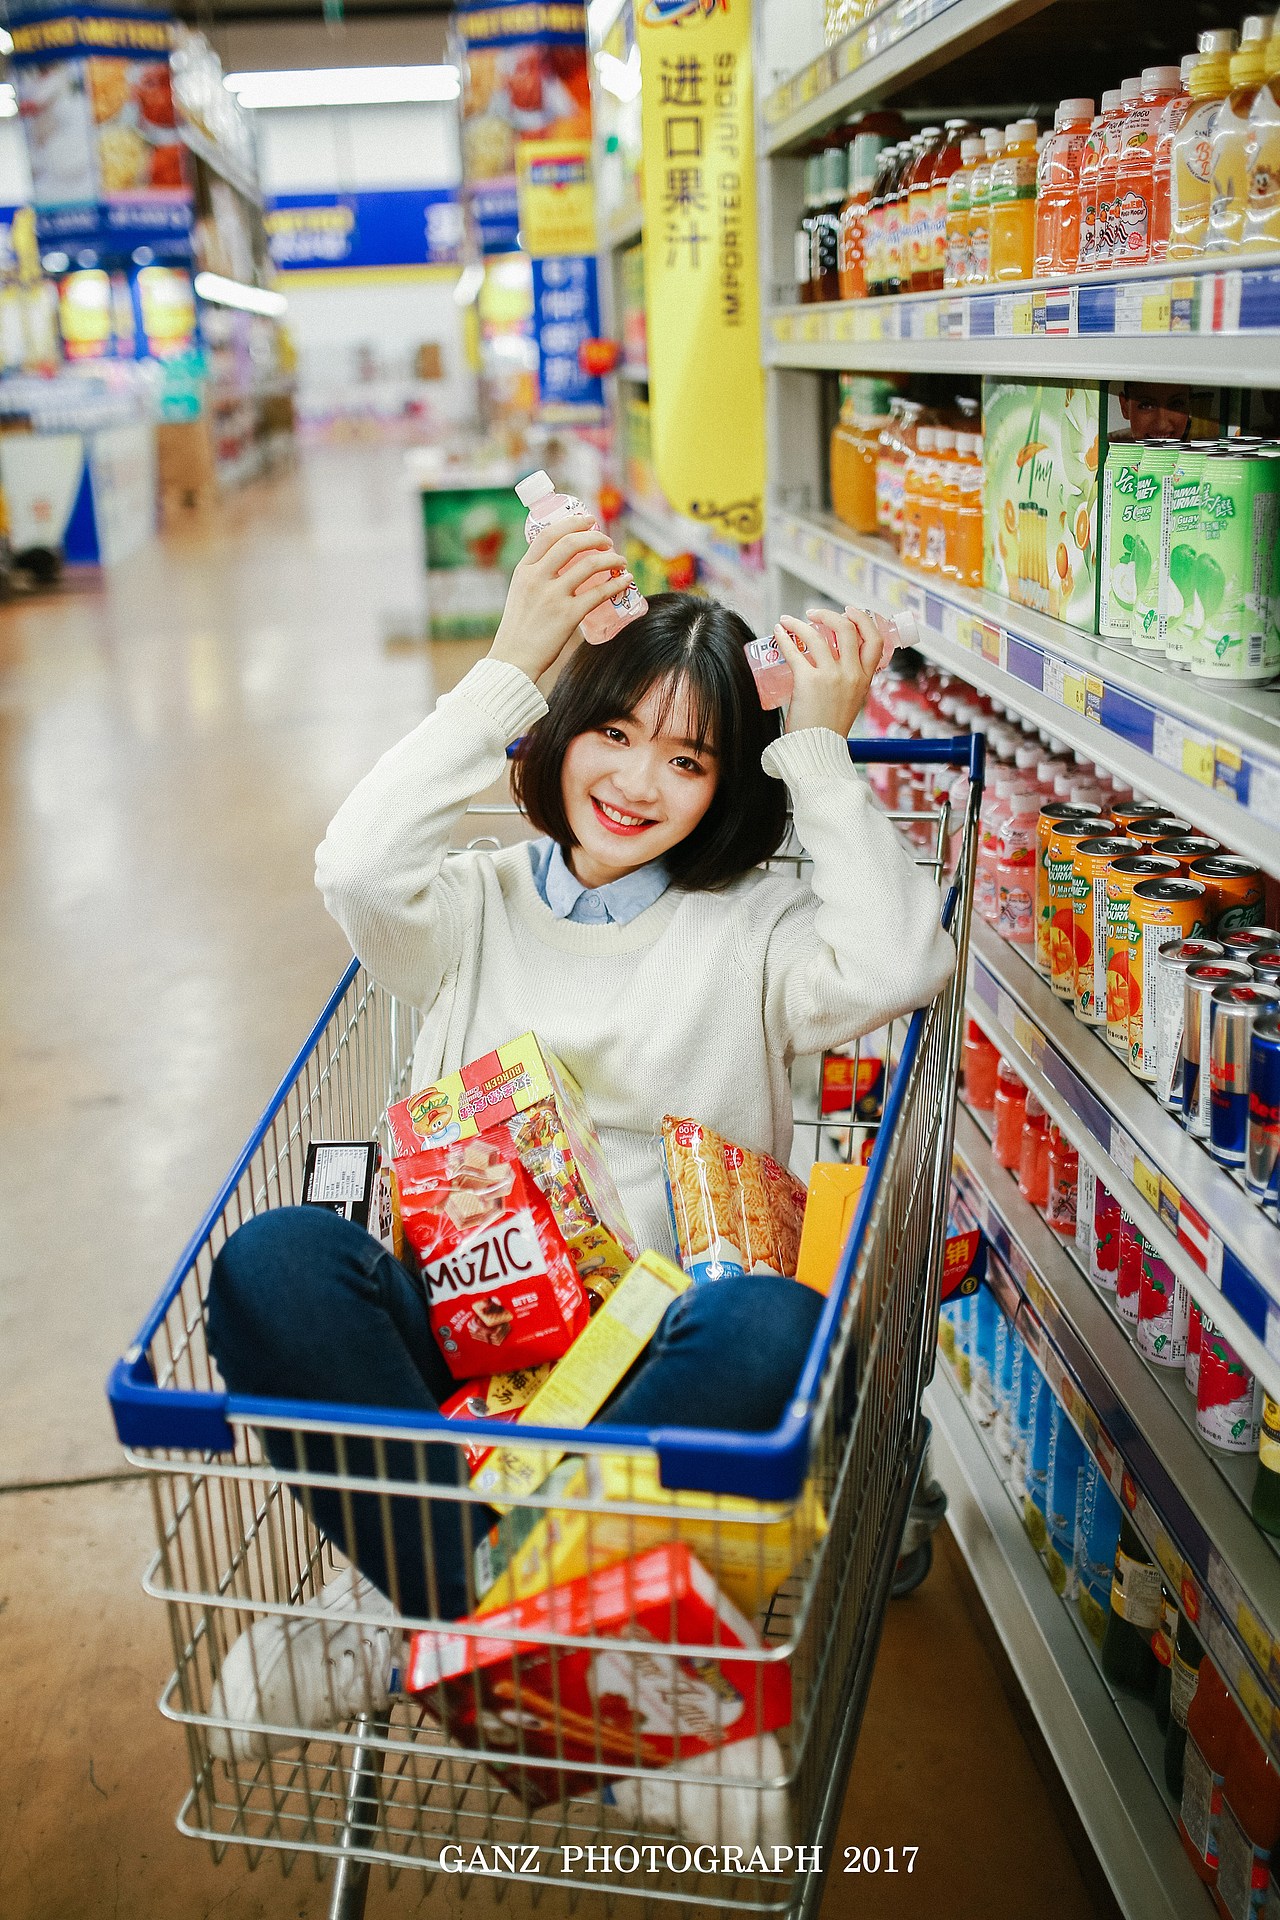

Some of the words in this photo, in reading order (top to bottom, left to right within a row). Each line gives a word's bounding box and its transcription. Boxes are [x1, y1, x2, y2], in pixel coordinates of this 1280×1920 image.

[713, 52, 740, 160] JUICES
[660, 53, 708, 270] 进口果汁
[717, 171, 743, 328] IMPORTED
[1178, 515, 1200, 525] Guav
[484, 1063, 523, 1091] BURGER
[945, 1238, 970, 1266] 销
